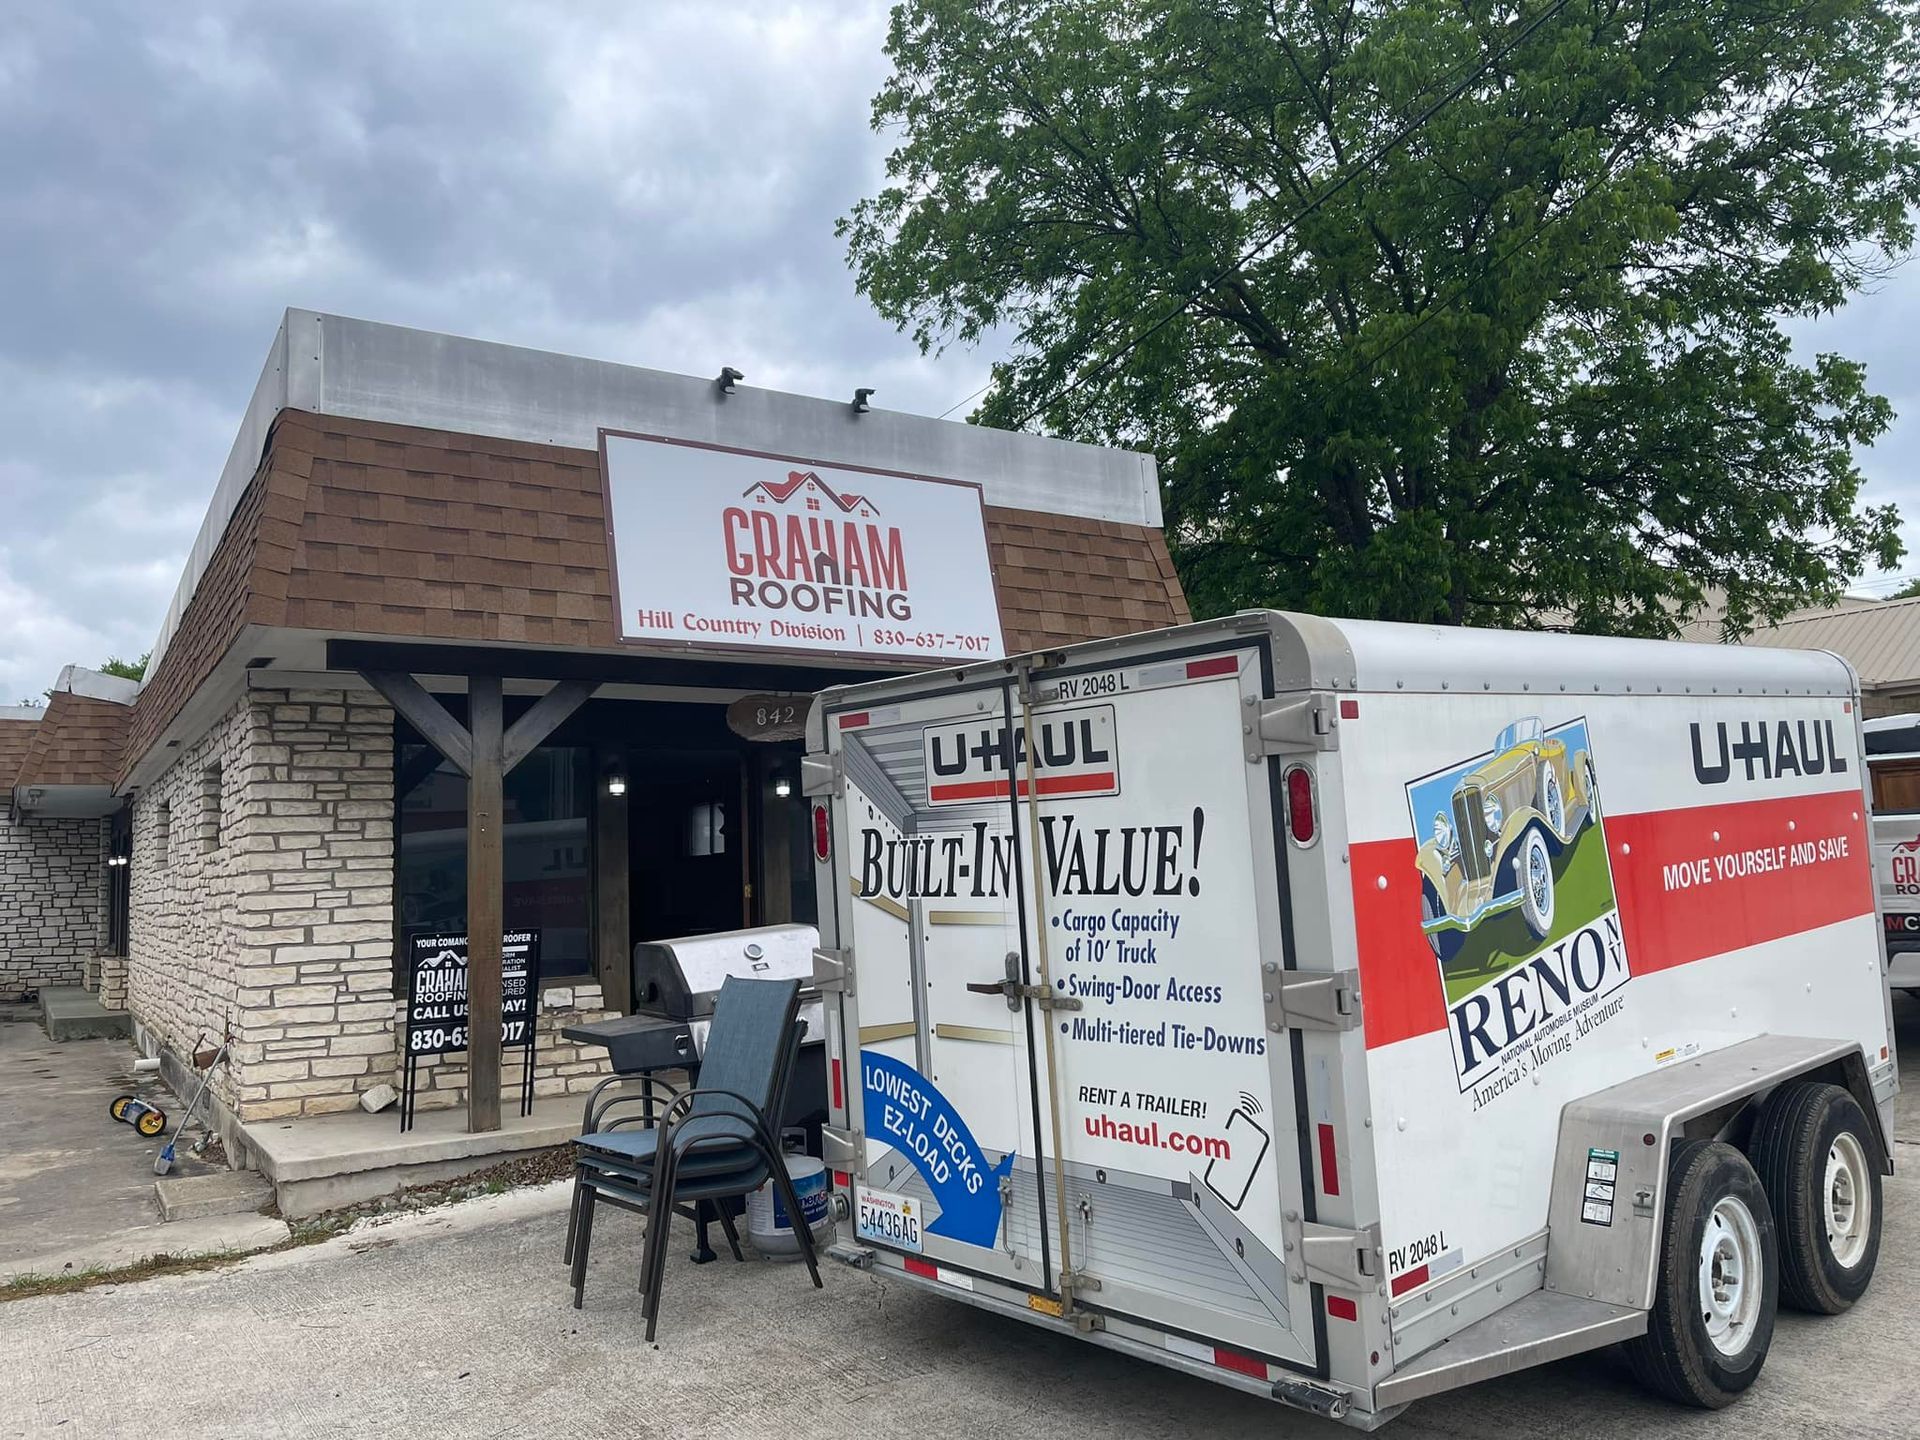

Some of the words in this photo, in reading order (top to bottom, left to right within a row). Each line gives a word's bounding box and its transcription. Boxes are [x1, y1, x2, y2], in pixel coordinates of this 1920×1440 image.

[723, 506, 908, 592] GRAHAM
[730, 577, 912, 621] ROOFING
[638, 609, 674, 630] Hill
[683, 612, 762, 640] Country
[771, 619, 846, 641] Division
[874, 629, 990, 652] 830-637-7017
[1059, 680, 1078, 699] RV
[1082, 674, 1117, 697] 2048
[1120, 672, 1130, 690] L
[757, 706, 794, 726] 842
[932, 719, 1109, 776] U-HAUL
[1690, 719, 1847, 785] U-HAUL
[1039, 806, 1205, 898] VALUE!
[1663, 859, 1712, 891] MOVE
[1713, 846, 1786, 881] YOURSELF
[1790, 842, 1817, 867] AND
[1819, 836, 1849, 860] SAVE
[416, 938, 437, 948] YOUR
[503, 933, 531, 943] ROOFER
[1063, 908, 1106, 937] Cargo
[1111, 908, 1180, 939] Capacity
[1065, 938, 1081, 962] of
[1117, 939, 1157, 964] Truck
[415, 991, 468, 1004] ROOFIN
[1069, 973, 1160, 1004] Swing-Door
[1166, 977, 1222, 1004] Access
[1449, 928, 1606, 1076] RENO
[413, 1005, 450, 1020] CALL
[1500, 1037, 1534, 1065] NATIONAL
[1534, 1009, 1572, 1042] AUTOMOBILE
[1572, 993, 1599, 1016] MUSEUM
[1072, 1017, 1166, 1048] Multi-tiered
[1172, 1024, 1265, 1056] Tie-Downs
[1473, 1058, 1528, 1112] America's
[1531, 1033, 1572, 1071] Moving
[1575, 997, 1625, 1041] Adventure
[1079, 1086, 1117, 1106] RENT
[1120, 1091, 1131, 1108] A
[1136, 1093, 1208, 1119] TRAILER!
[866, 1065, 932, 1121] LOWEST
[933, 1113, 983, 1194] DECKS
[884, 1104, 951, 1184] EZ-LOAD
[1085, 1113, 1231, 1161] uhaul.com
[861, 1205, 918, 1243] 54436AG
[1389, 1247, 1407, 1274] RV
[1409, 1235, 1437, 1265] 2048
[1440, 1230, 1449, 1250] L
